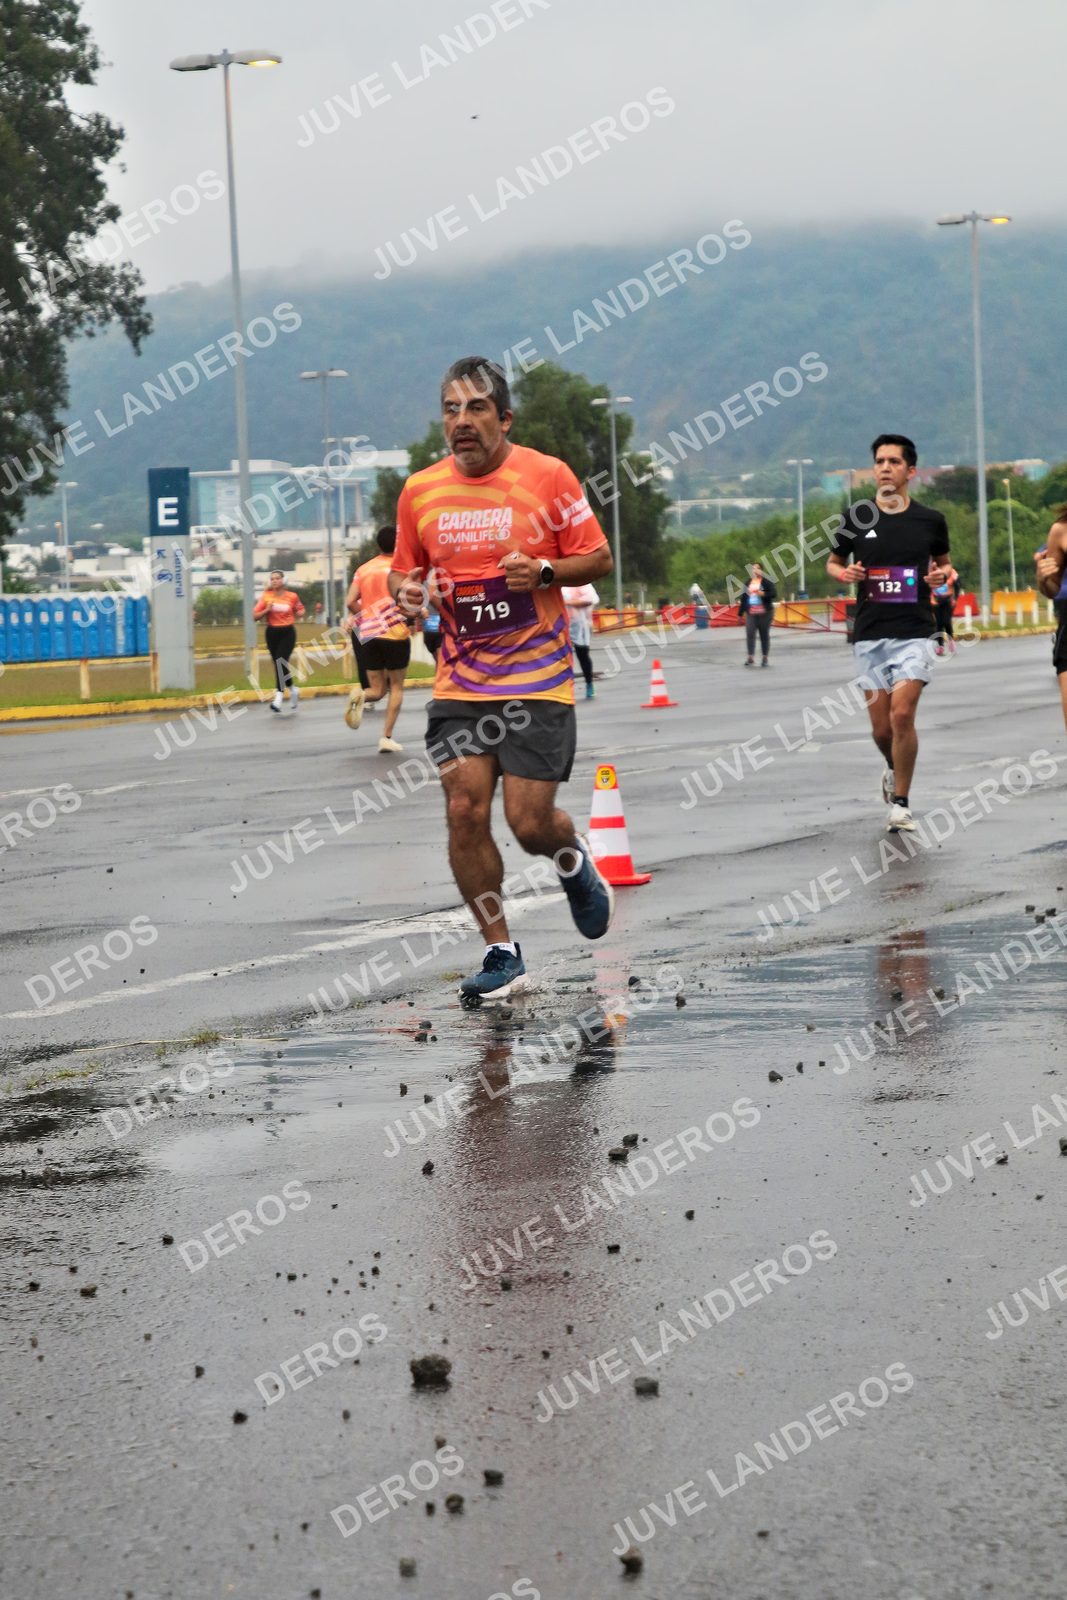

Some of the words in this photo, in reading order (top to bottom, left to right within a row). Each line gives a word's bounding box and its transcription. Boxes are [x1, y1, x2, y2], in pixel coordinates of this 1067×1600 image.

[157, 496, 180, 527] E
[438, 507, 513, 531] CARRERA
[438, 529, 495, 545] OMNILIFE
[878, 581, 902, 593] 132
[472, 601, 511, 623] 719
